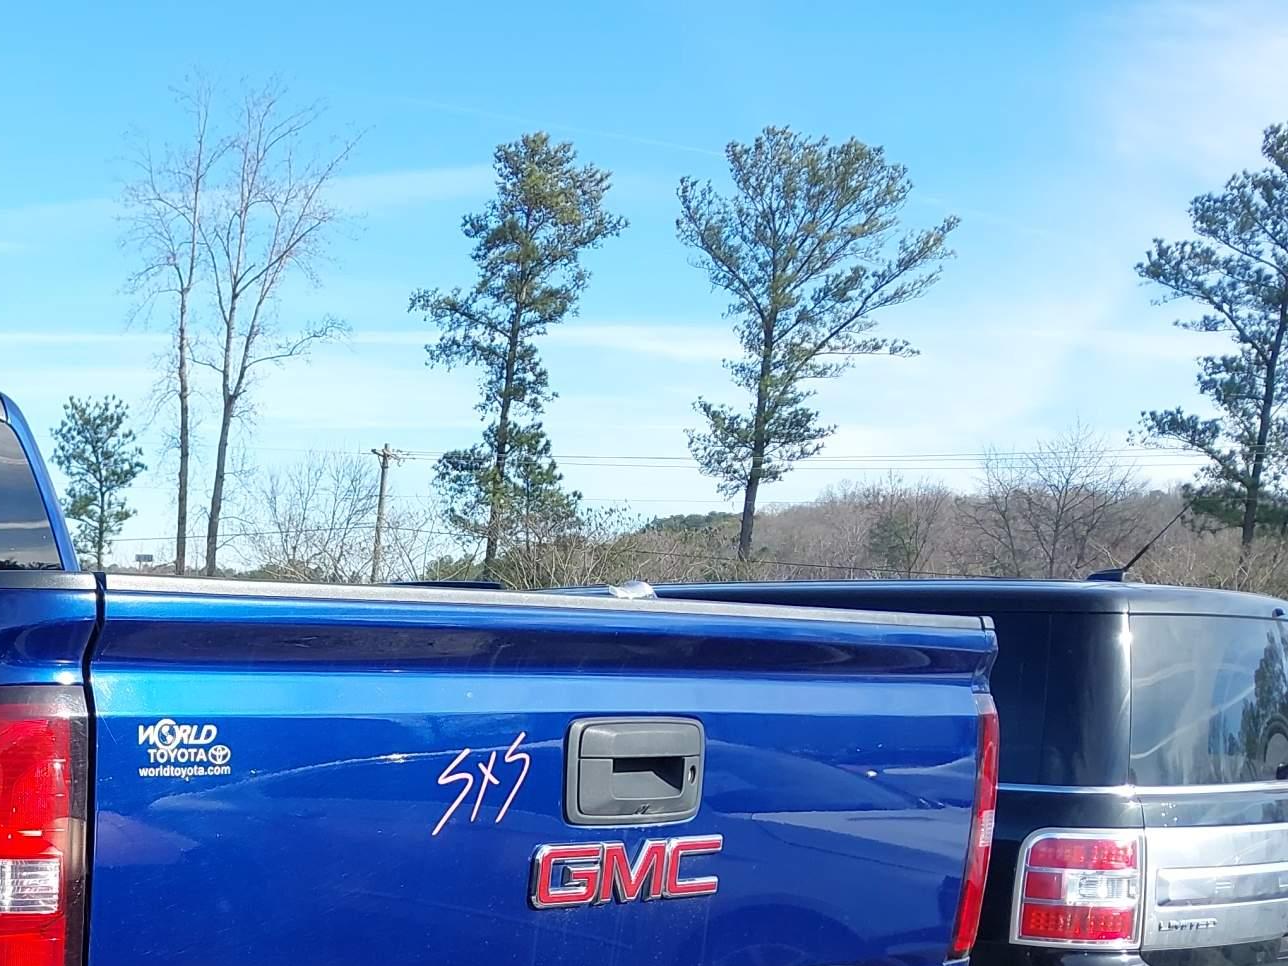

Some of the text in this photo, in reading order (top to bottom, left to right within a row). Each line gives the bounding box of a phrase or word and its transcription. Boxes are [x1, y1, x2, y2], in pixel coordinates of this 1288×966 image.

[137, 718, 217, 749] WORLD
[147, 748, 207, 763] TOYOTA
[138, 765, 231, 779] worldtoyota.com
[528, 834, 723, 911] GMC
